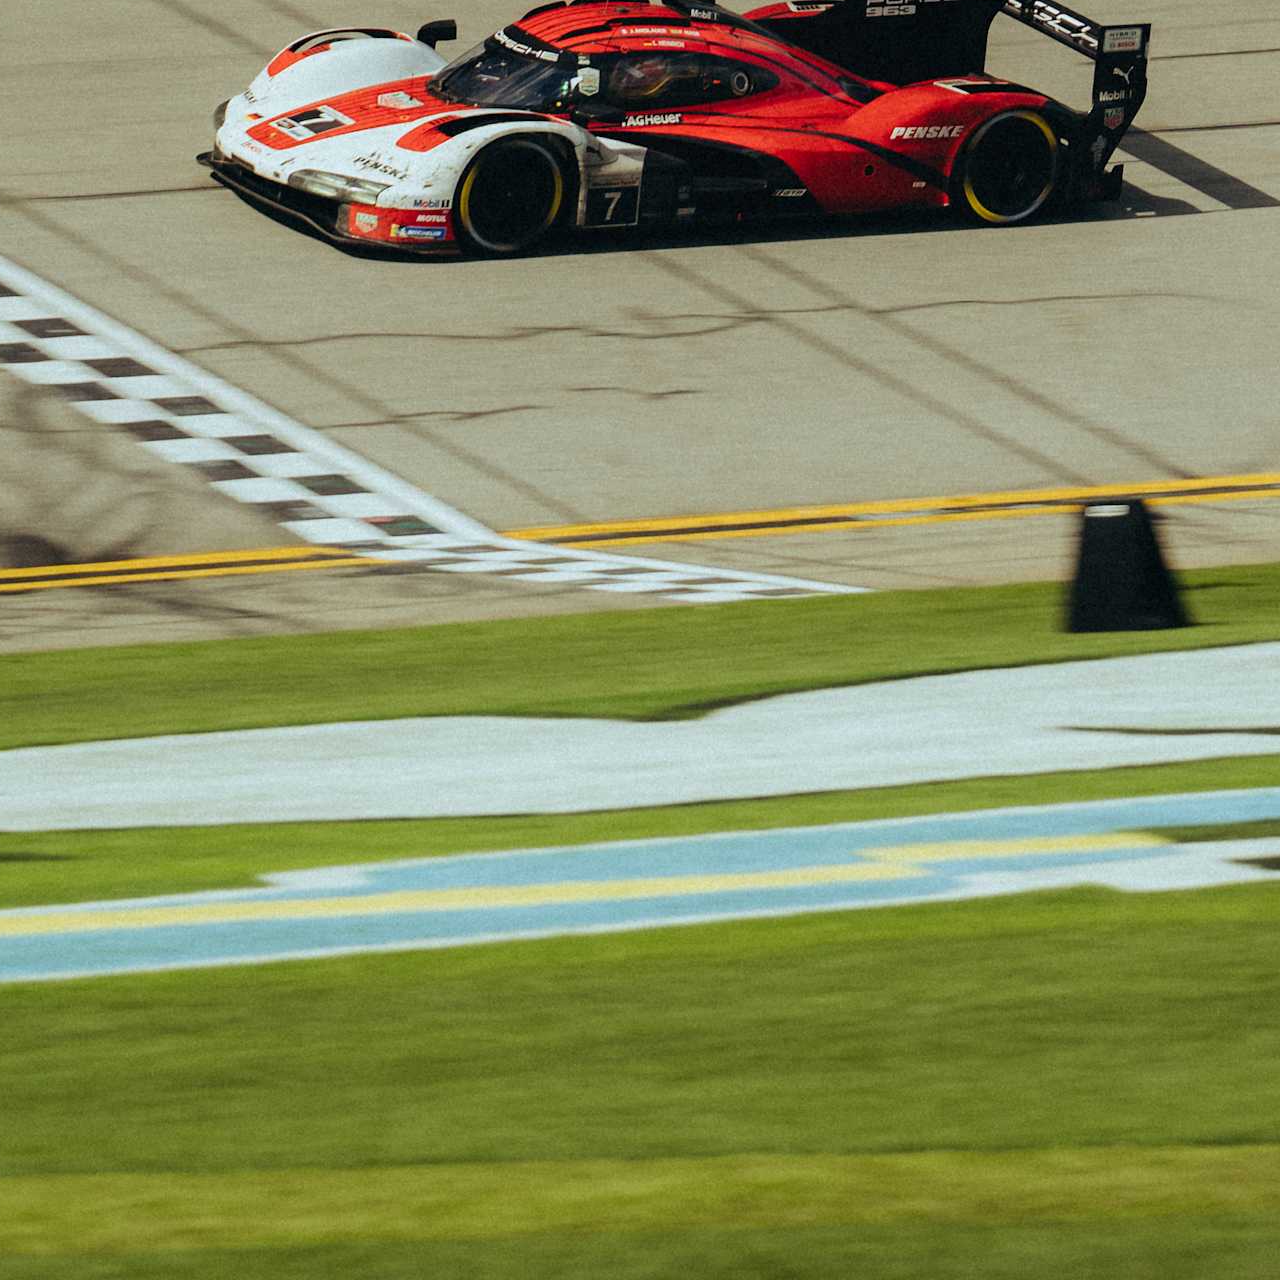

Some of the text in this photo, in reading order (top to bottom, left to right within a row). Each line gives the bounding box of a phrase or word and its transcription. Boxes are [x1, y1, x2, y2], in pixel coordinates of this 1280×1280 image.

[866, 5, 916, 17] 963
[890, 125, 964, 140] PENSKE
[414, 199, 440, 209] Mobil
[604, 191, 622, 221] 7
